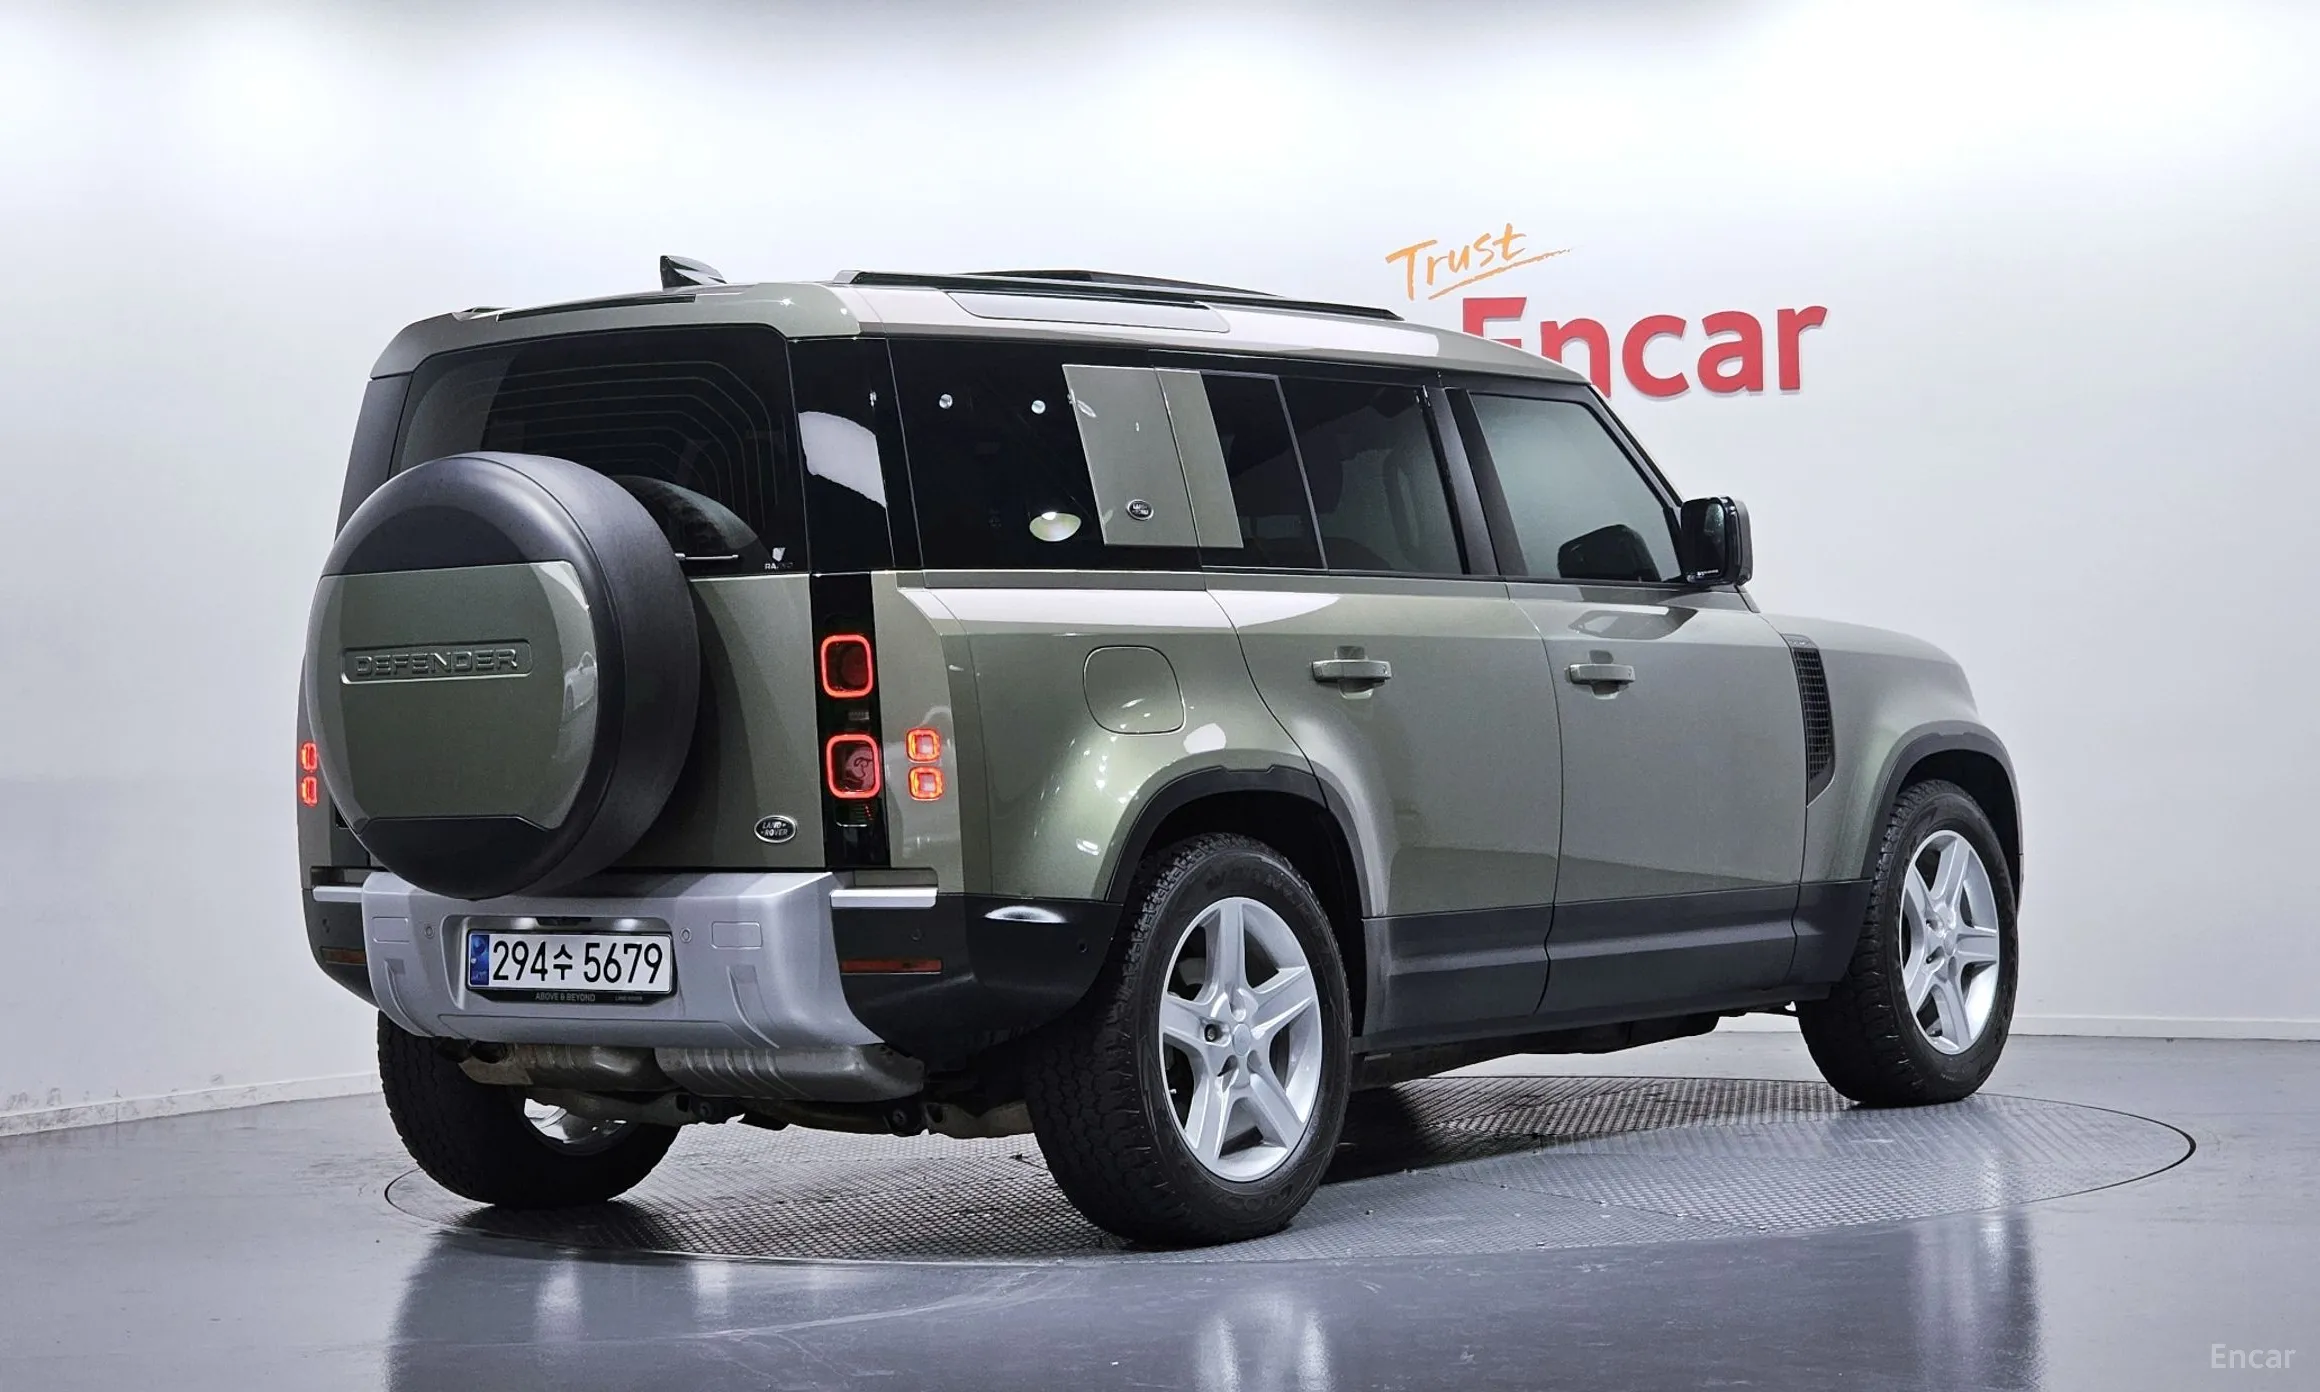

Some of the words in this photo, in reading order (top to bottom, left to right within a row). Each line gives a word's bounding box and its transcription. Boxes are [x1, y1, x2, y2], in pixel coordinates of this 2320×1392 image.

[1385, 222, 1526, 300] Trust
[354, 648, 518, 676] DEFENDER
[583, 942, 664, 984] 5679
[535, 992, 559, 1001] ABOVE
[566, 992, 596, 1002] BEYOND
